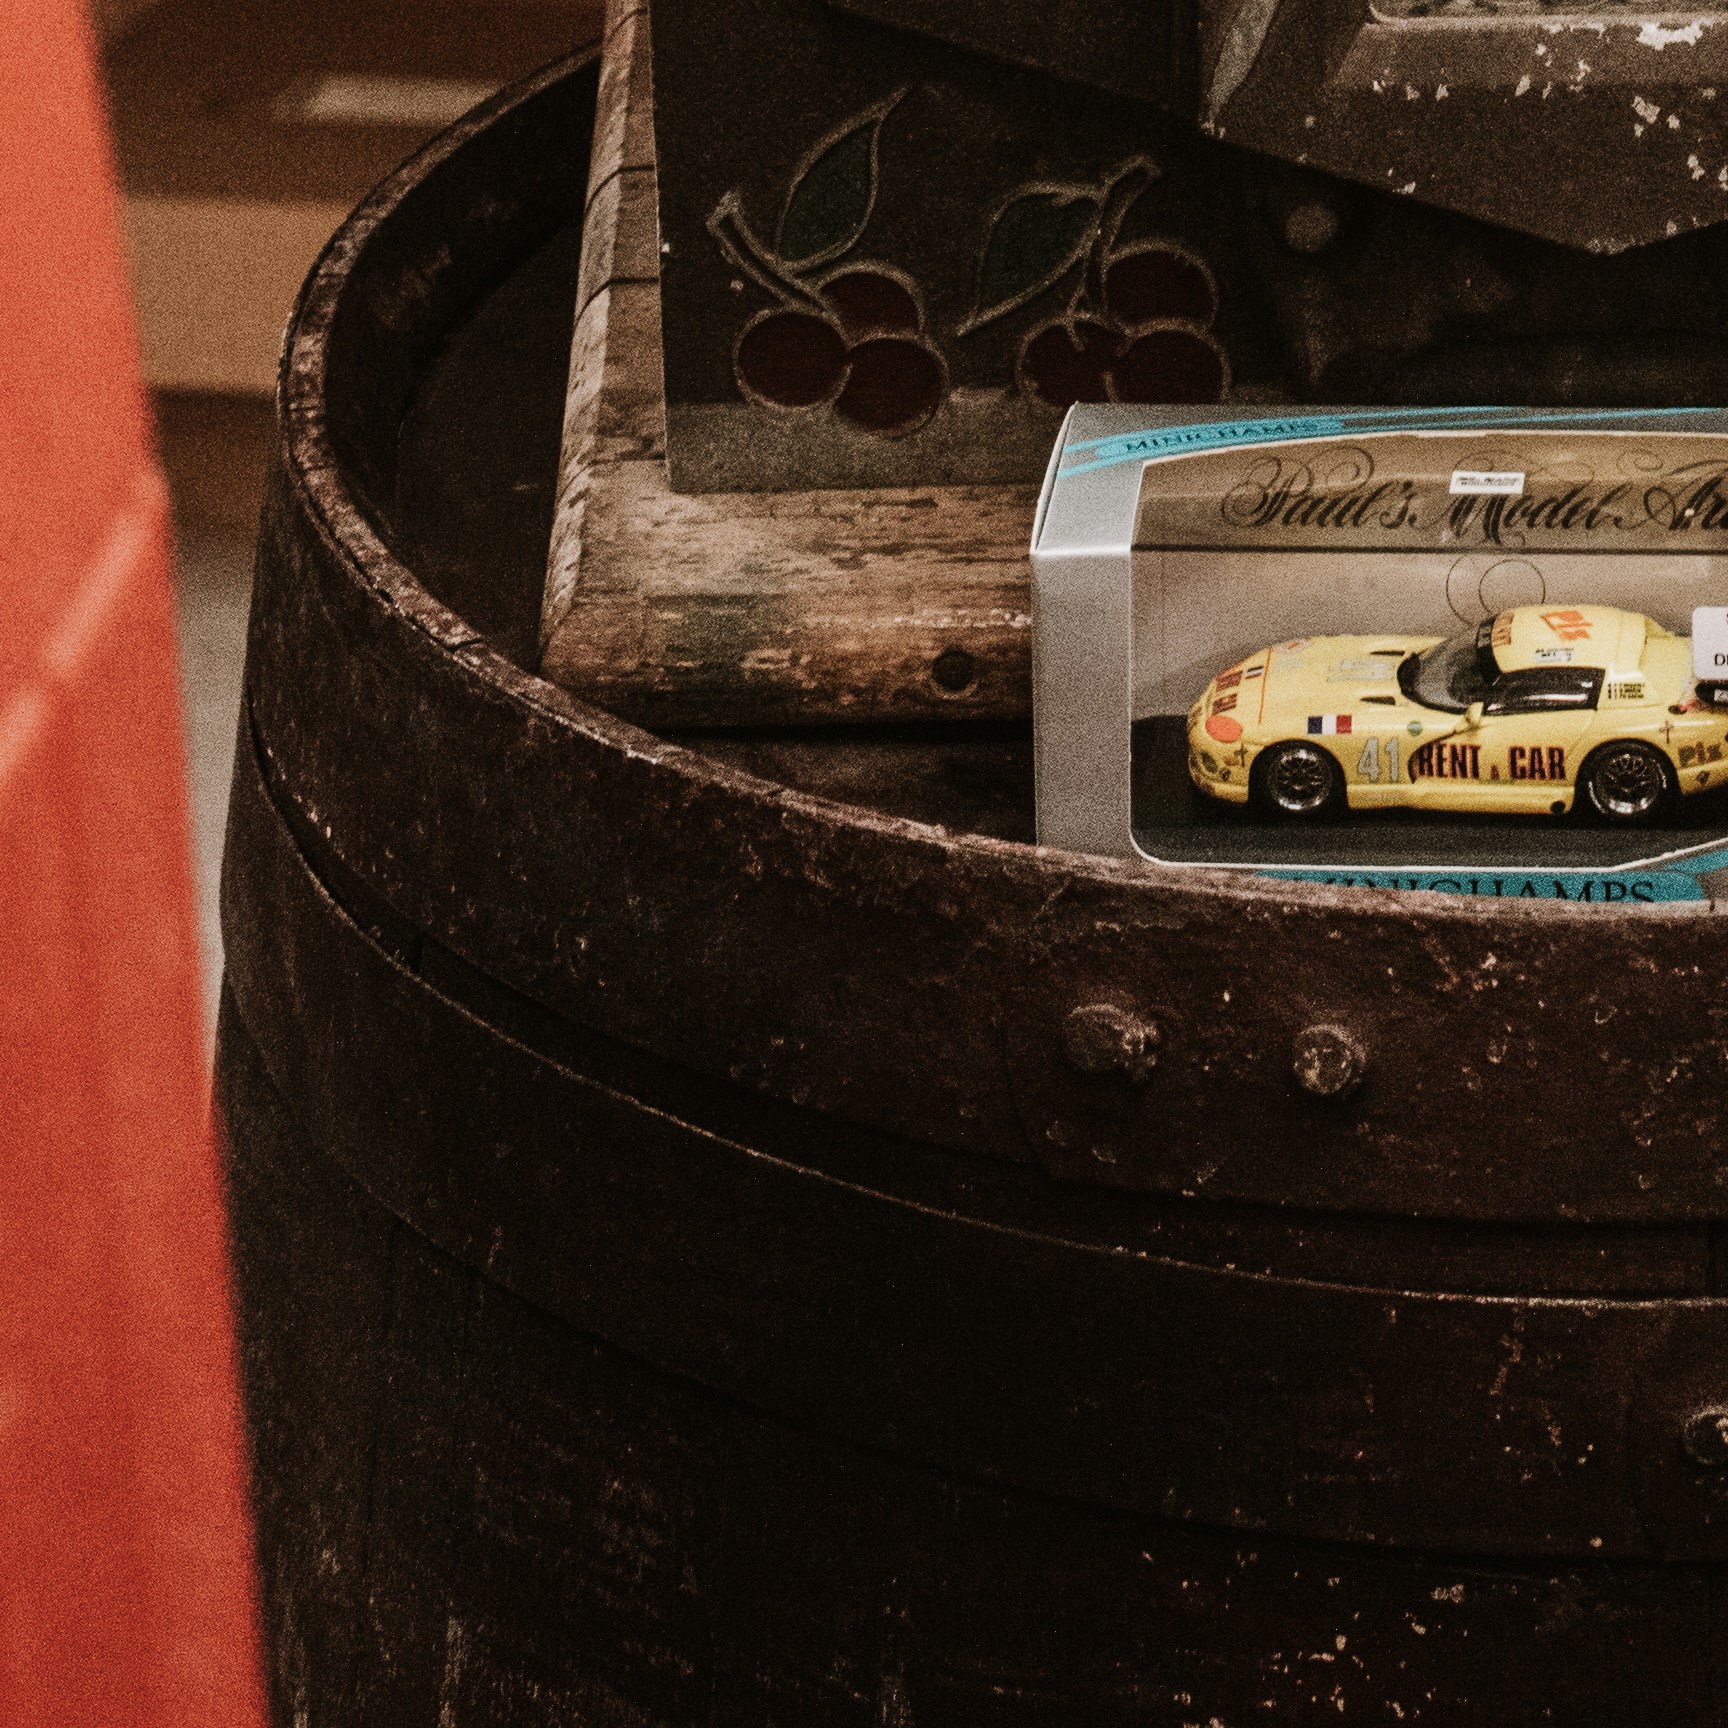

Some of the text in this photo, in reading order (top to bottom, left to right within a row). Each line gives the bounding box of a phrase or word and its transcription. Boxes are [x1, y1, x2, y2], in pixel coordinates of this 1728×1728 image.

[1356, 735, 1402, 785] 41
[1414, 743, 1482, 780] RENT
[1507, 745, 1567, 780] CAR
